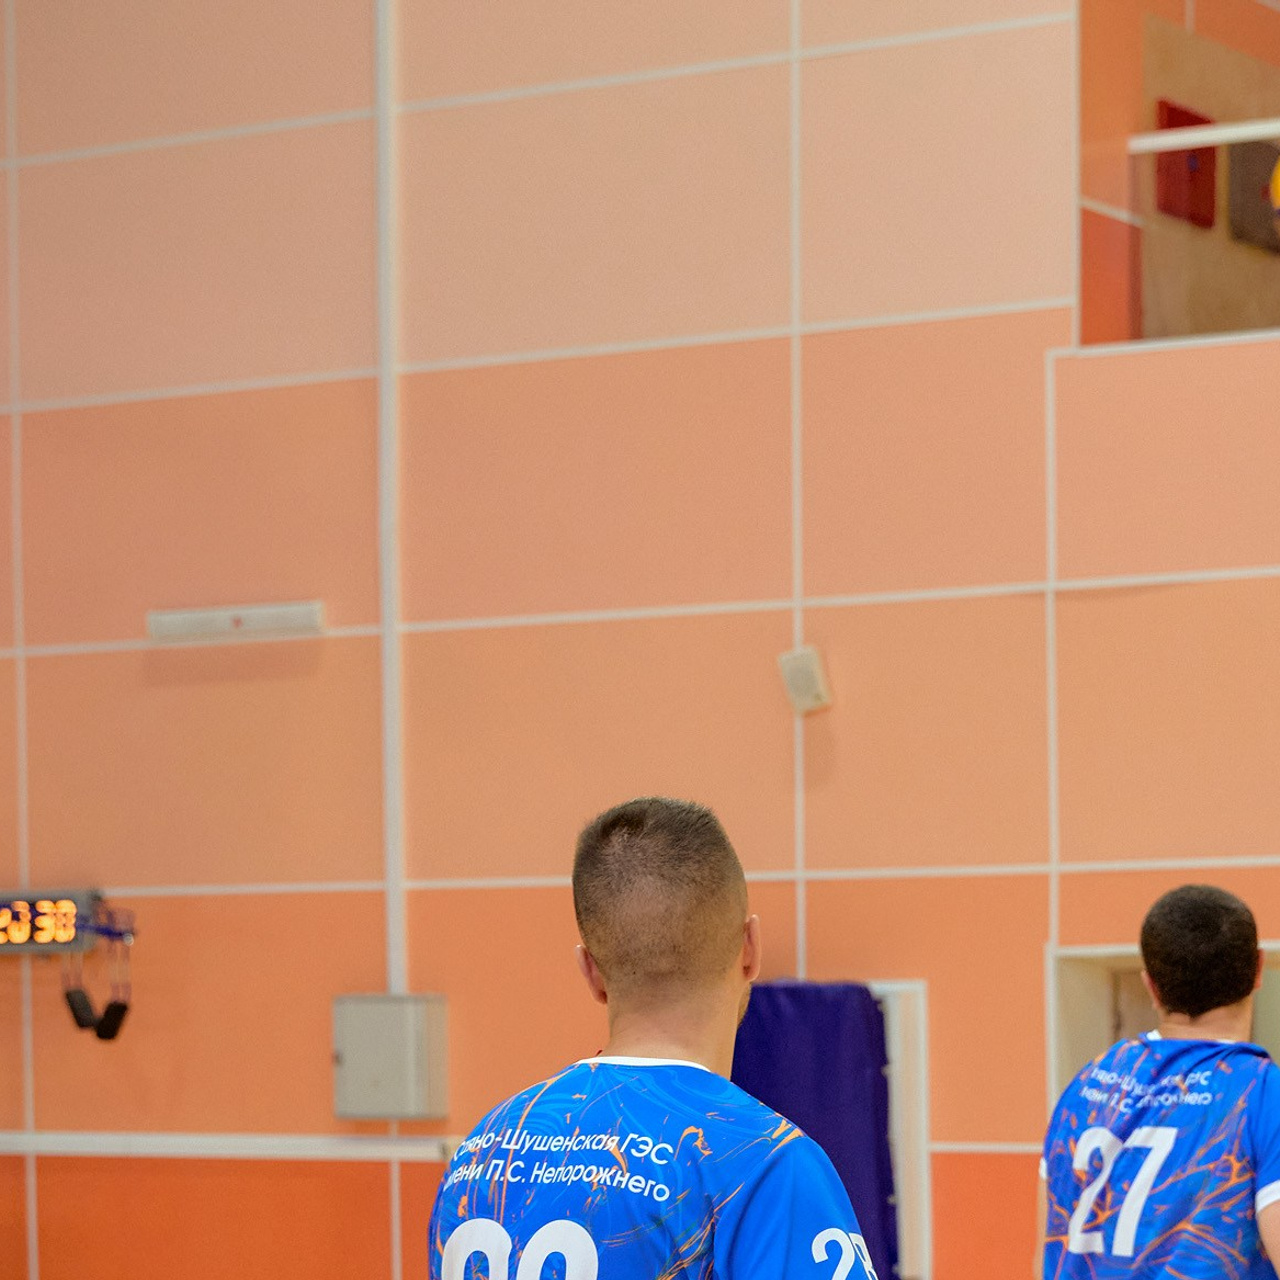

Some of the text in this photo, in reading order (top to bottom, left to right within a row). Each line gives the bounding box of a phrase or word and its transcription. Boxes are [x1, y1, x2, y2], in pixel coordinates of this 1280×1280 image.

[619, 1132, 674, 1165] ГЭС
[485, 1159, 526, 1183] П.С.
[529, 1161, 671, 1201] Непорожнего
[1068, 1126, 1179, 1257] 27
